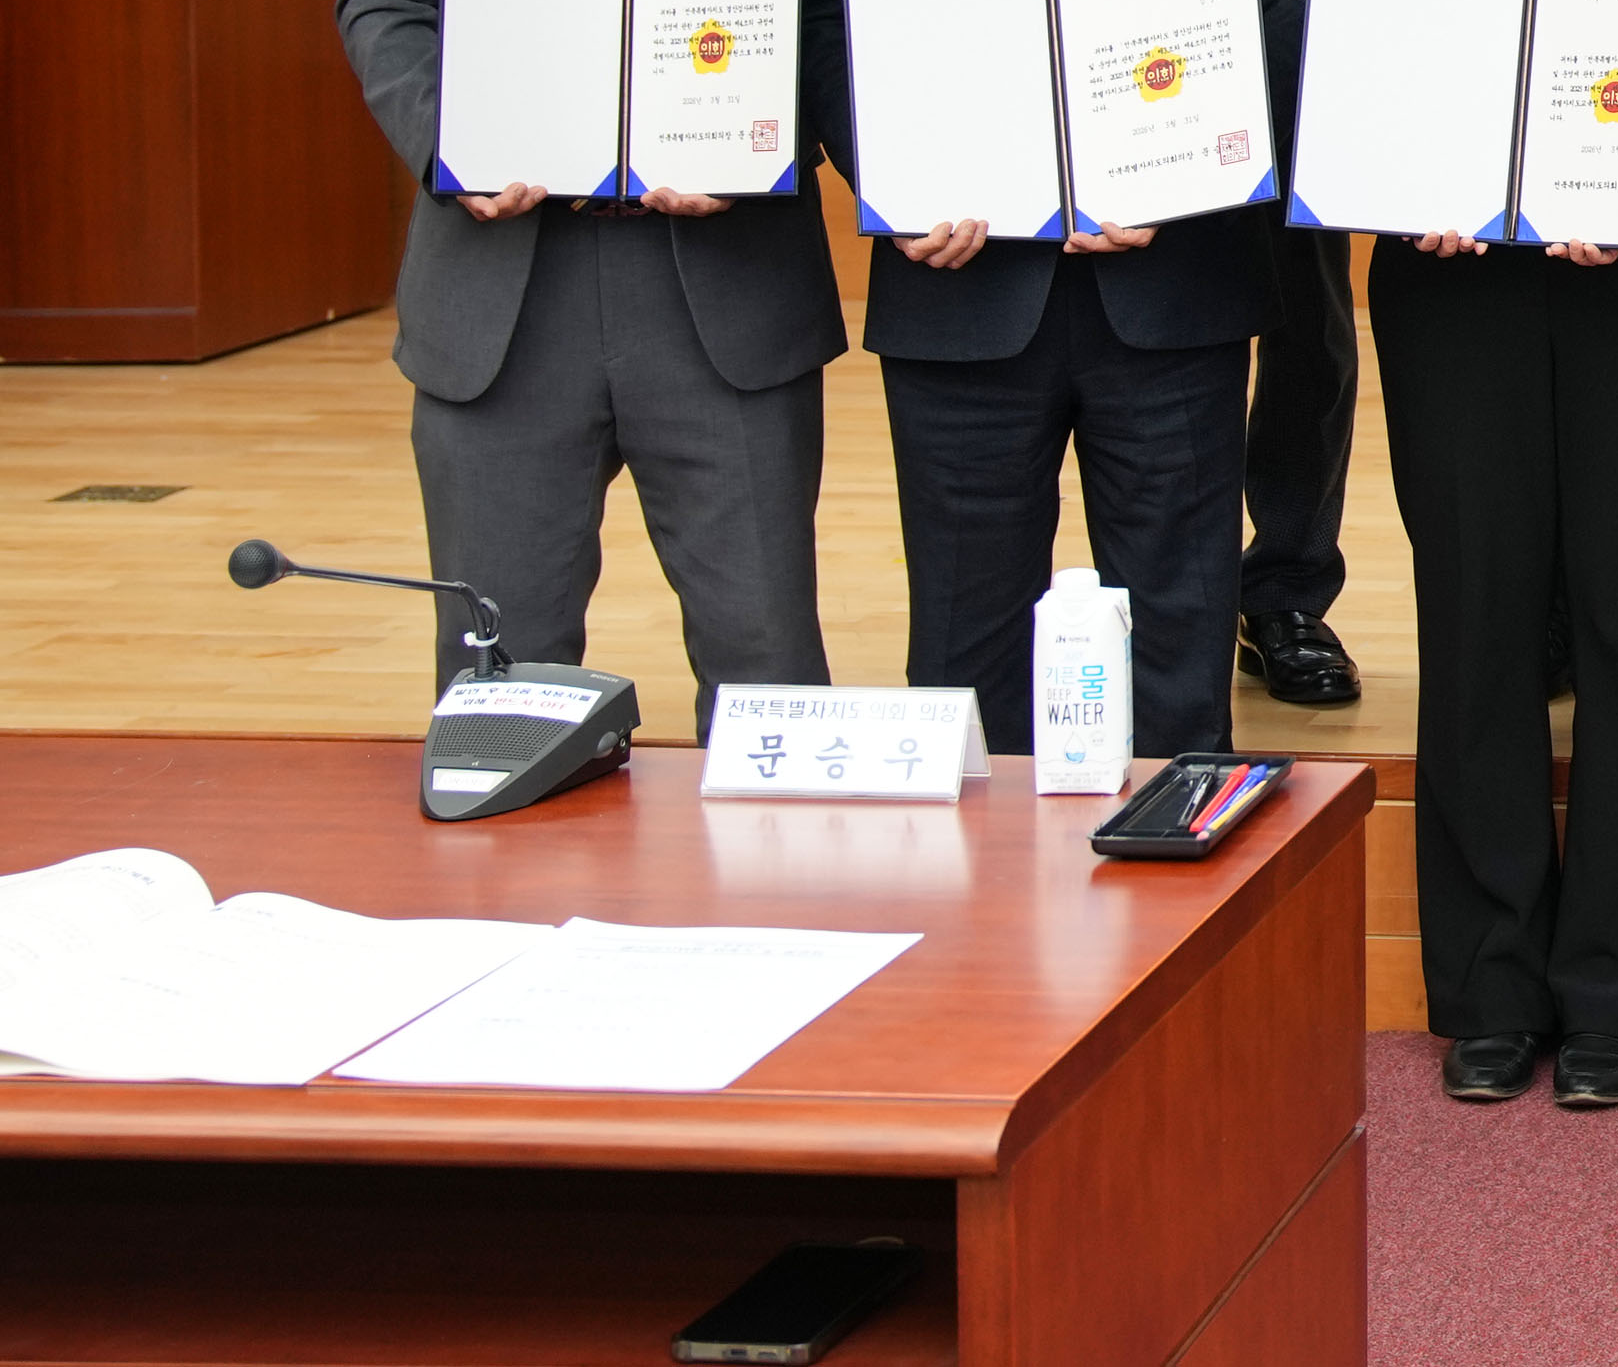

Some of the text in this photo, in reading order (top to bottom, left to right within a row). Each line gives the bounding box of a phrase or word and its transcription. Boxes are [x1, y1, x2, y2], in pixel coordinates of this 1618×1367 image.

[699, 39, 724, 56] 의회
[1145, 64, 1174, 85] 의회
[1077, 665, 1108, 700] 물
[1047, 688, 1072, 701] DEEP
[1047, 703, 1105, 726] WATER
[747, 734, 923, 781] 문 승 우
